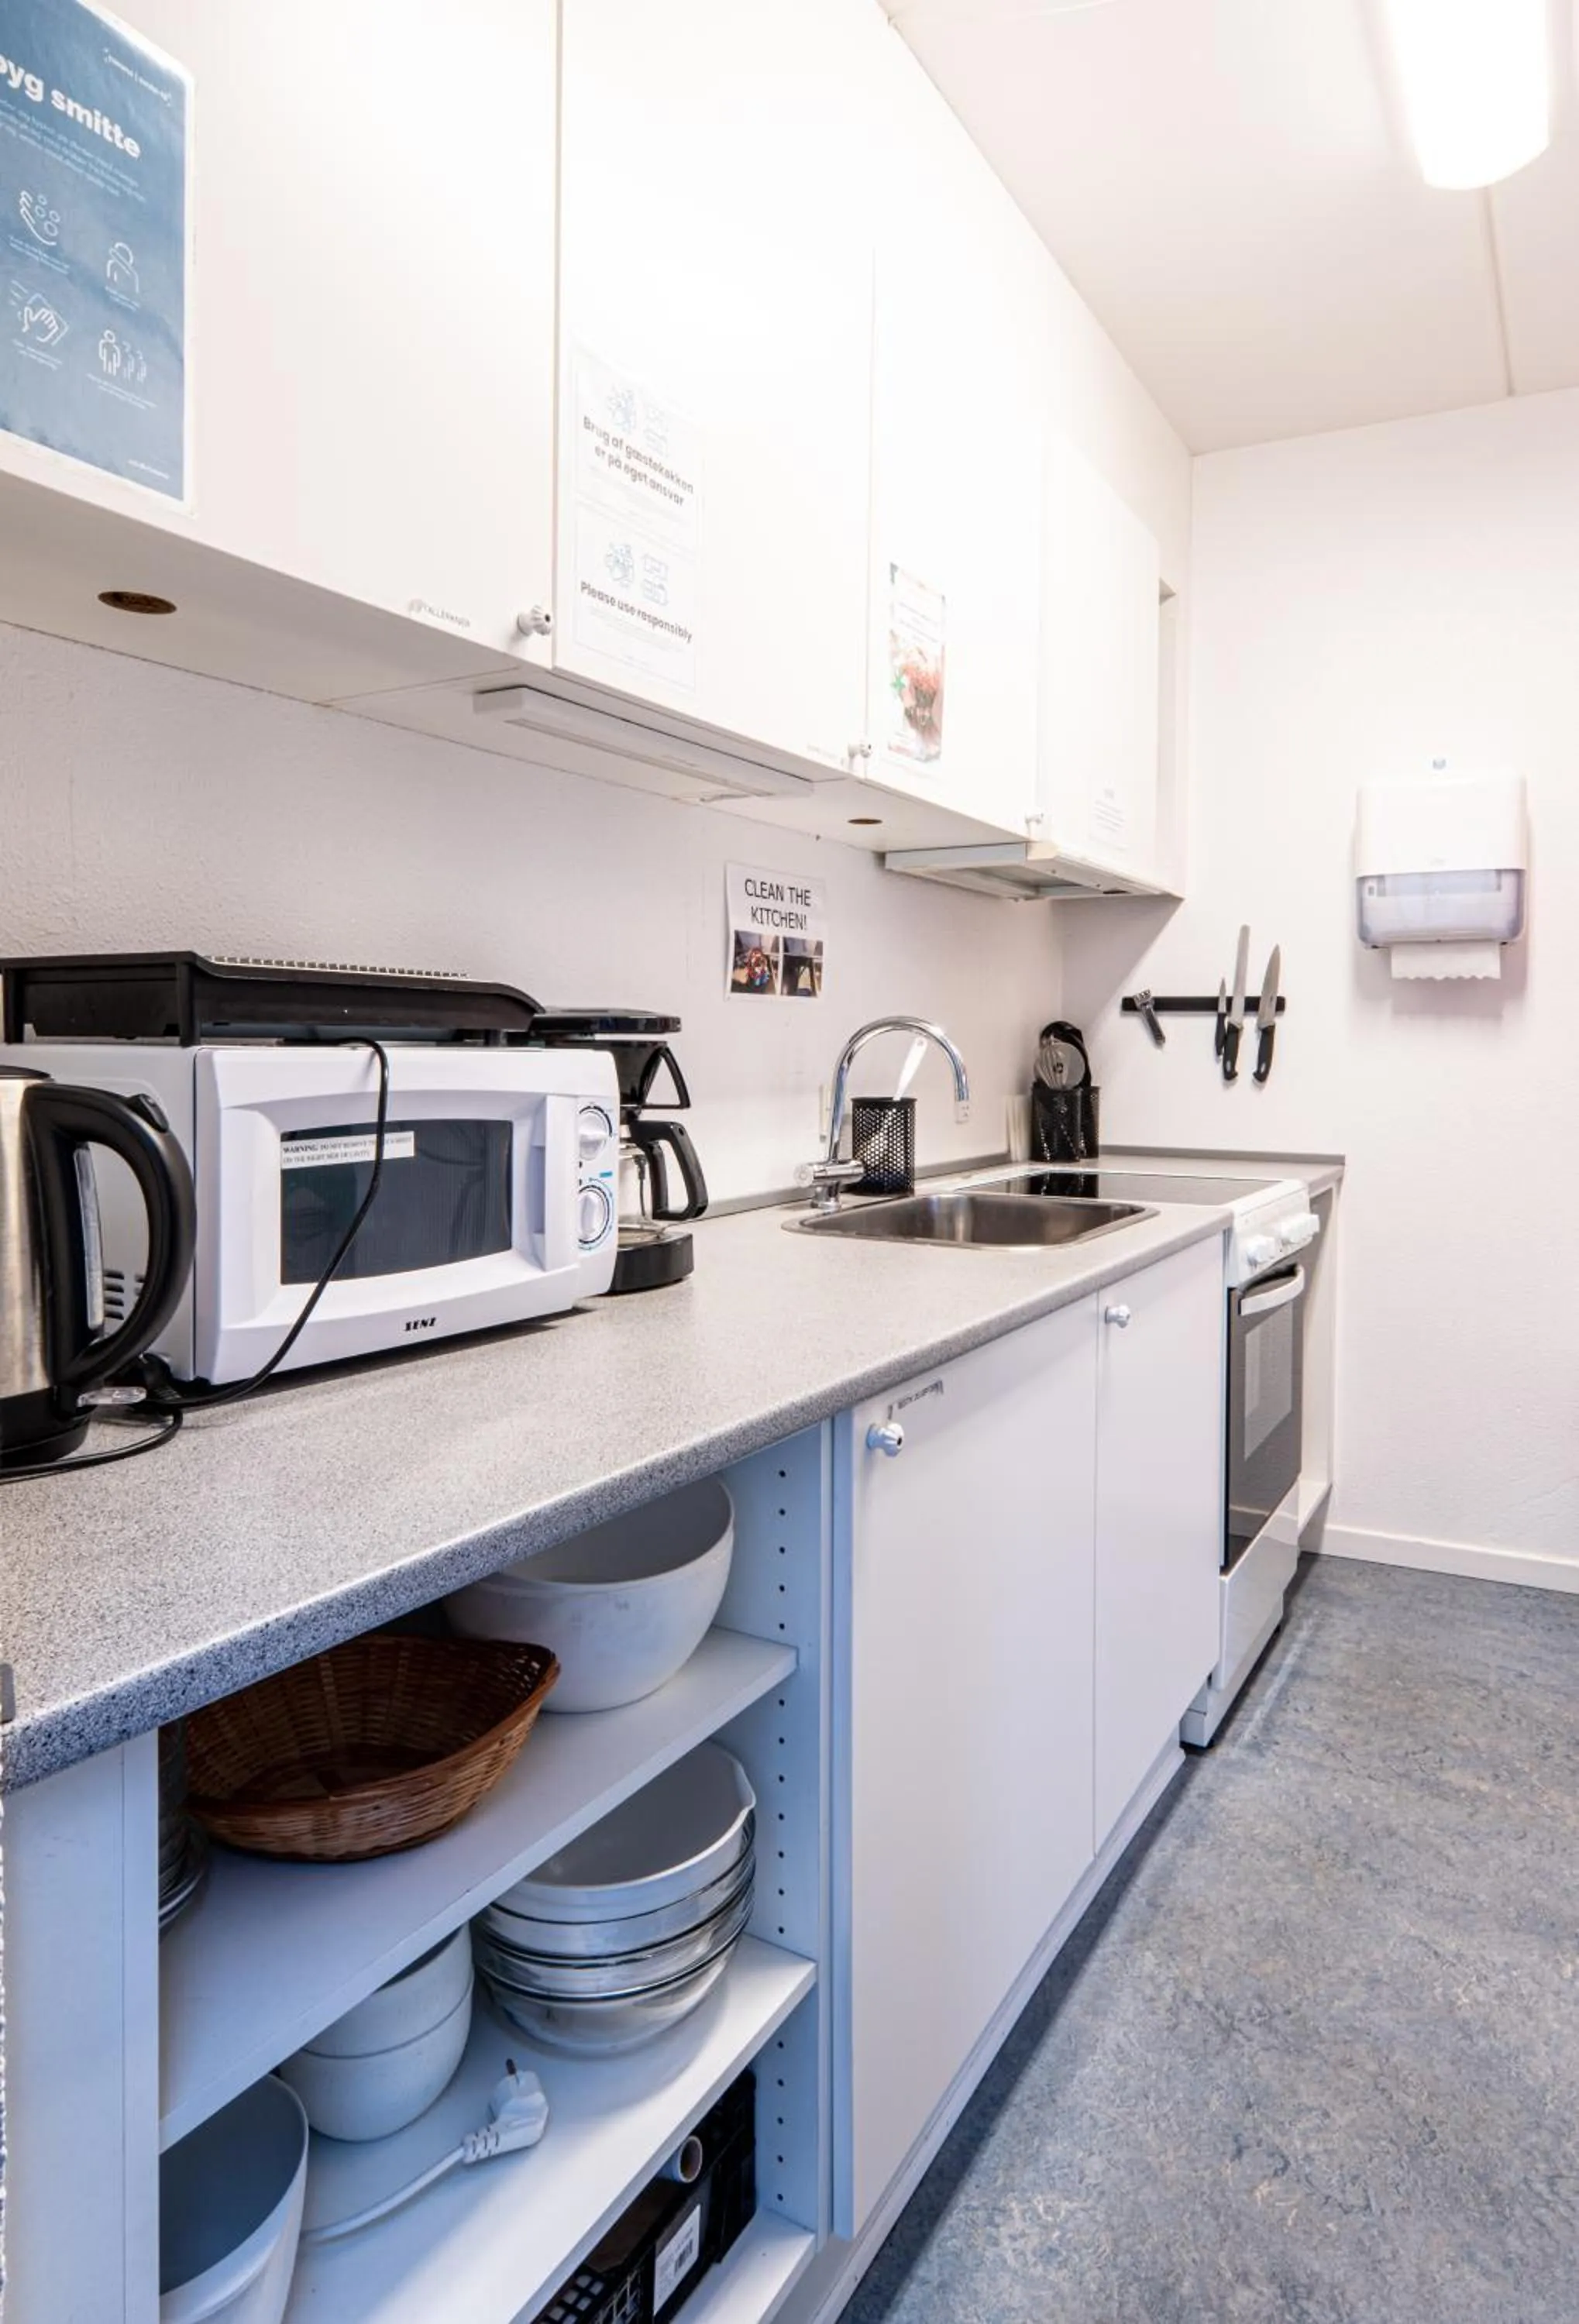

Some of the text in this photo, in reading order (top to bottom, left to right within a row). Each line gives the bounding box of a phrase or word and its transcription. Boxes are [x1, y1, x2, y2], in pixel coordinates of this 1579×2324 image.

[51, 88, 141, 158] smitte
[583, 416, 610, 446] Brug
[612, 437, 624, 450] af
[594, 445, 606, 459] er
[648, 478, 684, 506] ansvar
[580, 581, 616, 607] Please
[617, 600, 636, 616] use
[637, 609, 693, 644] responsibly
[745, 878, 811, 906] CLEAN THE
[751, 906, 807, 930] KITCHEN!
